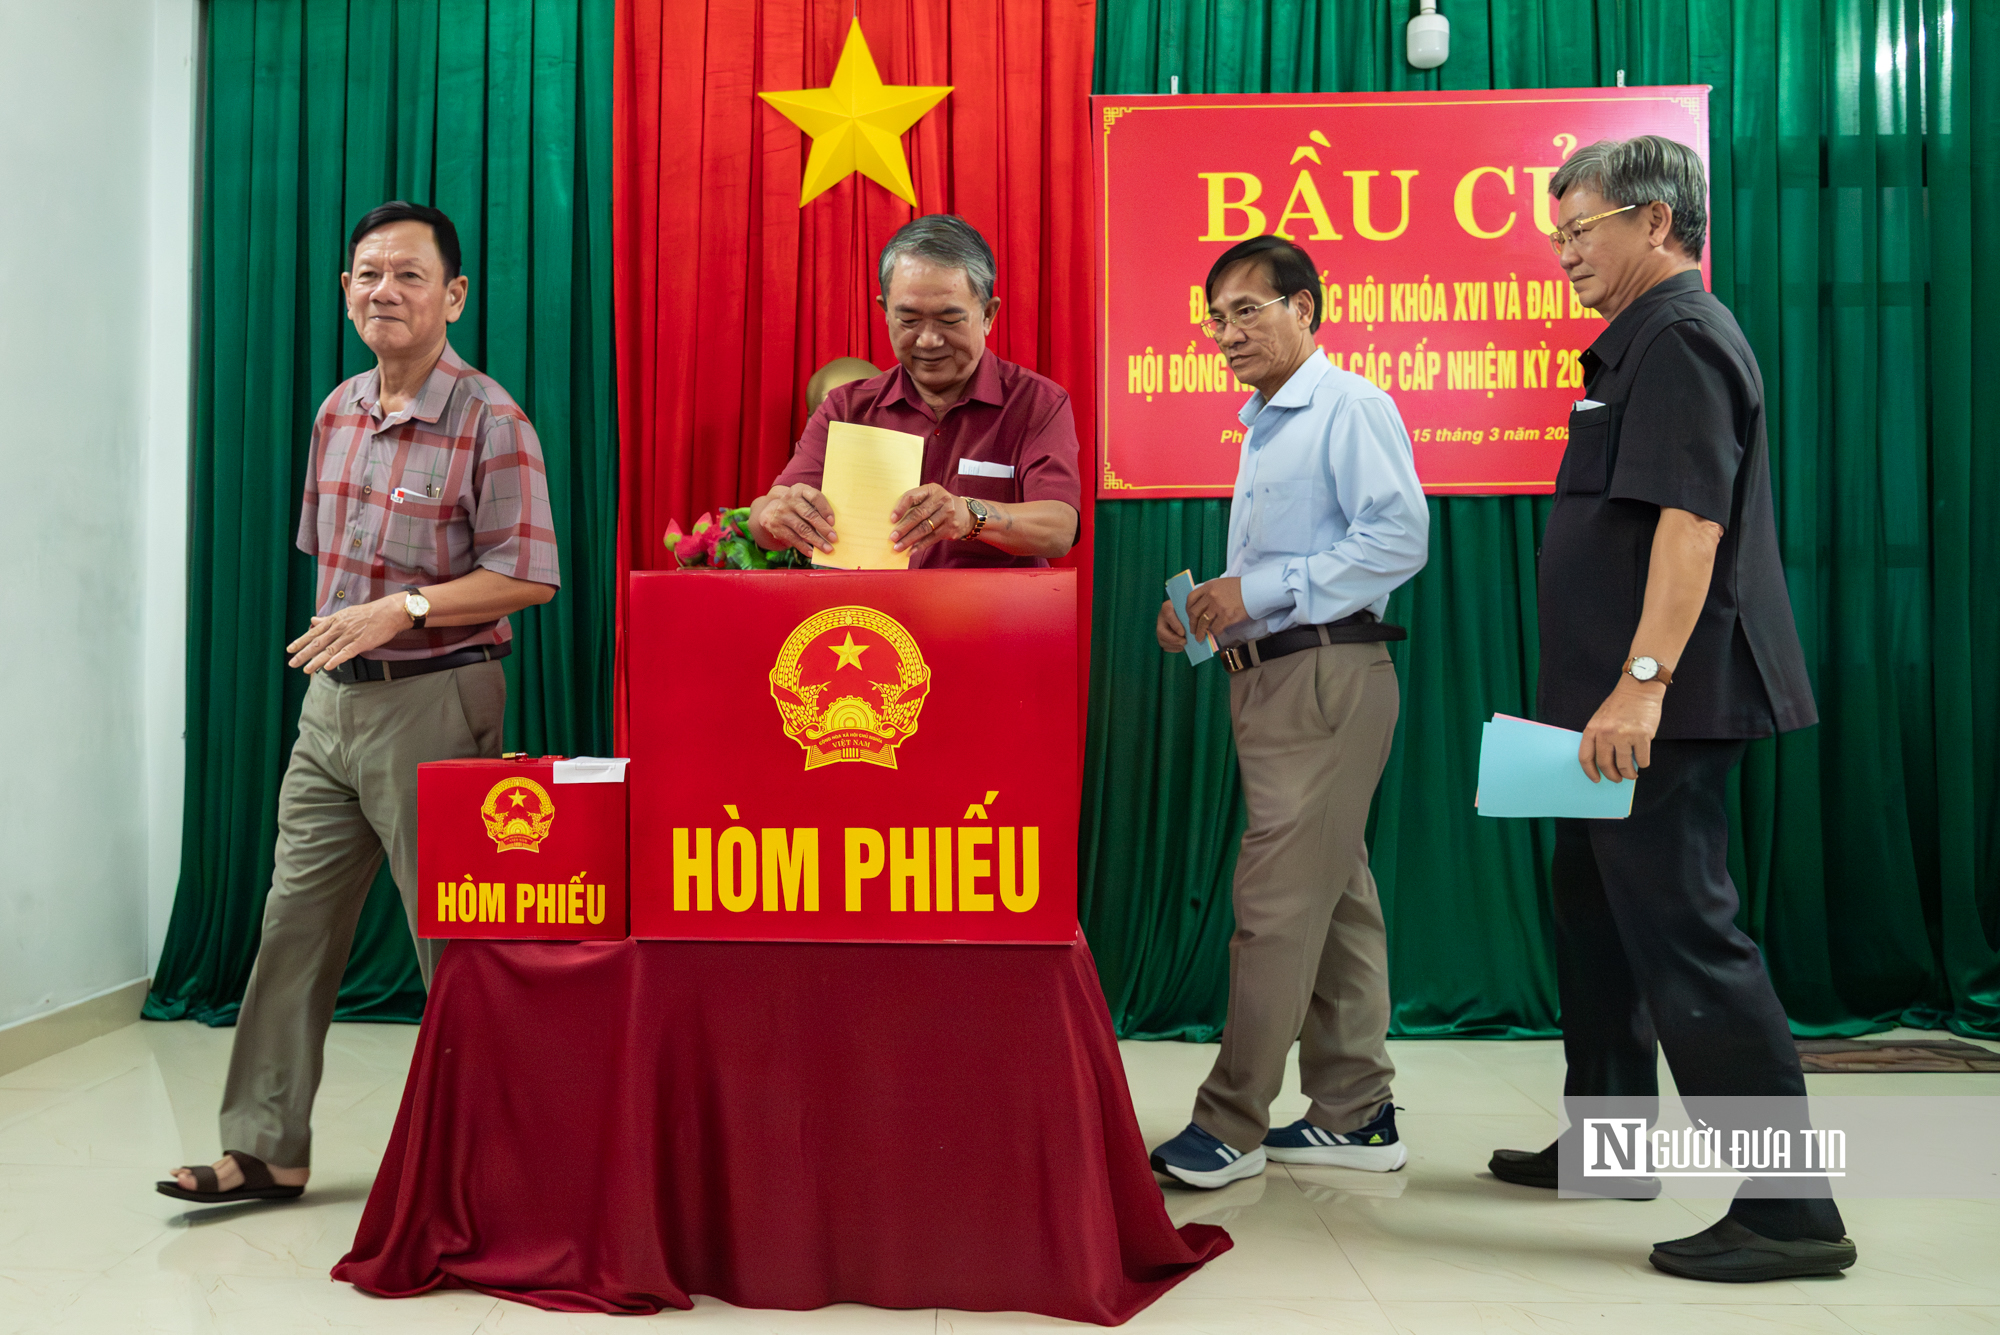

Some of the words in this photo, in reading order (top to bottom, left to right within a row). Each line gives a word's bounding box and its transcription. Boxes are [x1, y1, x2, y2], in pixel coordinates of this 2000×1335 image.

[1197, 130, 1420, 242] BẦU
[1348, 275, 1385, 332] HỘI
[1390, 274, 1449, 323] KHÓA
[1453, 282, 1489, 322] XVI
[1493, 272, 1522, 321] VÀ
[1526, 280, 1563, 329] ĐẠI
[1128, 346, 1163, 402] HỘI
[1169, 340, 1228, 393] ĐỒNG
[1349, 343, 1393, 392] CÁC
[1398, 337, 1441, 392] CẤP
[1447, 341, 1518, 399] NHIỆM
[1523, 340, 1551, 389] KỲ
[1413, 428, 1432, 442] 15
[1435, 427, 1484, 446] tháng
[1488, 427, 1500, 442] 3
[1504, 427, 1540, 441] năm
[853, 739, 870, 747] NAM
[672, 805, 820, 912] HÒM
[844, 790, 1040, 912] PHIẾU
[437, 873, 506, 923] HÒM
[516, 871, 606, 925] PHIẾU
